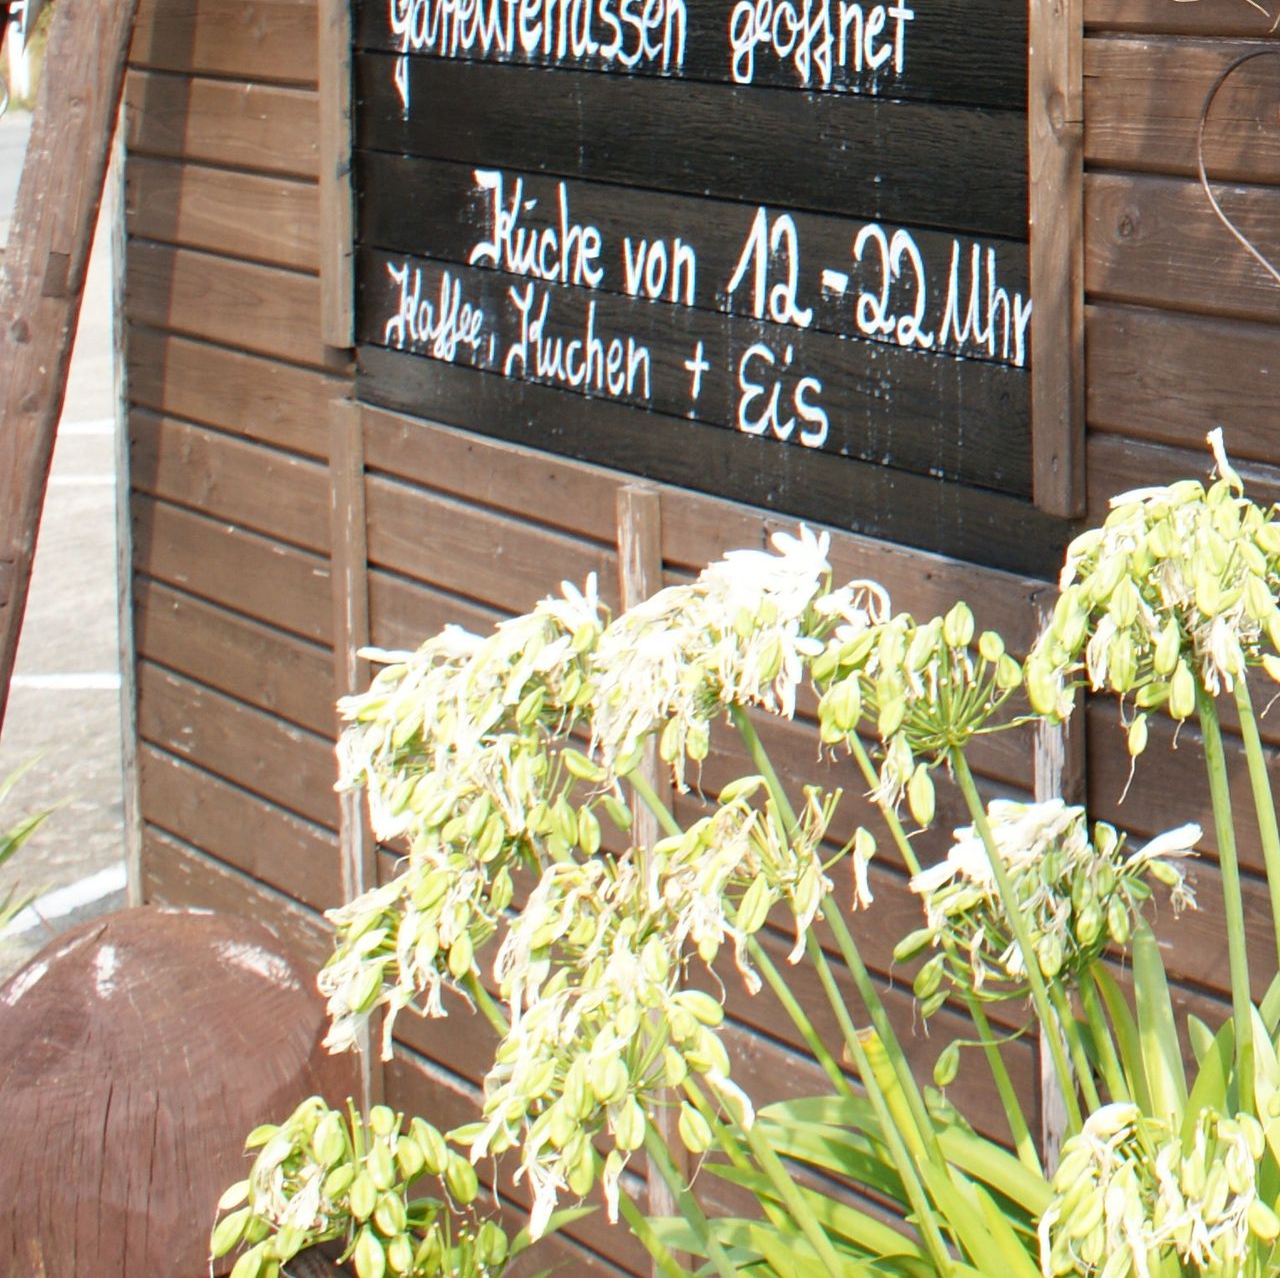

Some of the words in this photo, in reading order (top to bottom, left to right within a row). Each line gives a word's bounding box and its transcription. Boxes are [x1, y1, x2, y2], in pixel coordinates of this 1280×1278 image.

[469, 169, 605, 289] Küche
[622, 237, 697, 307] von
[938, 238, 1032, 368] Uhr
[503, 281, 650, 399] Kuchen
[684, 341, 711, 400] +
[737, 342, 830, 448] Eis
